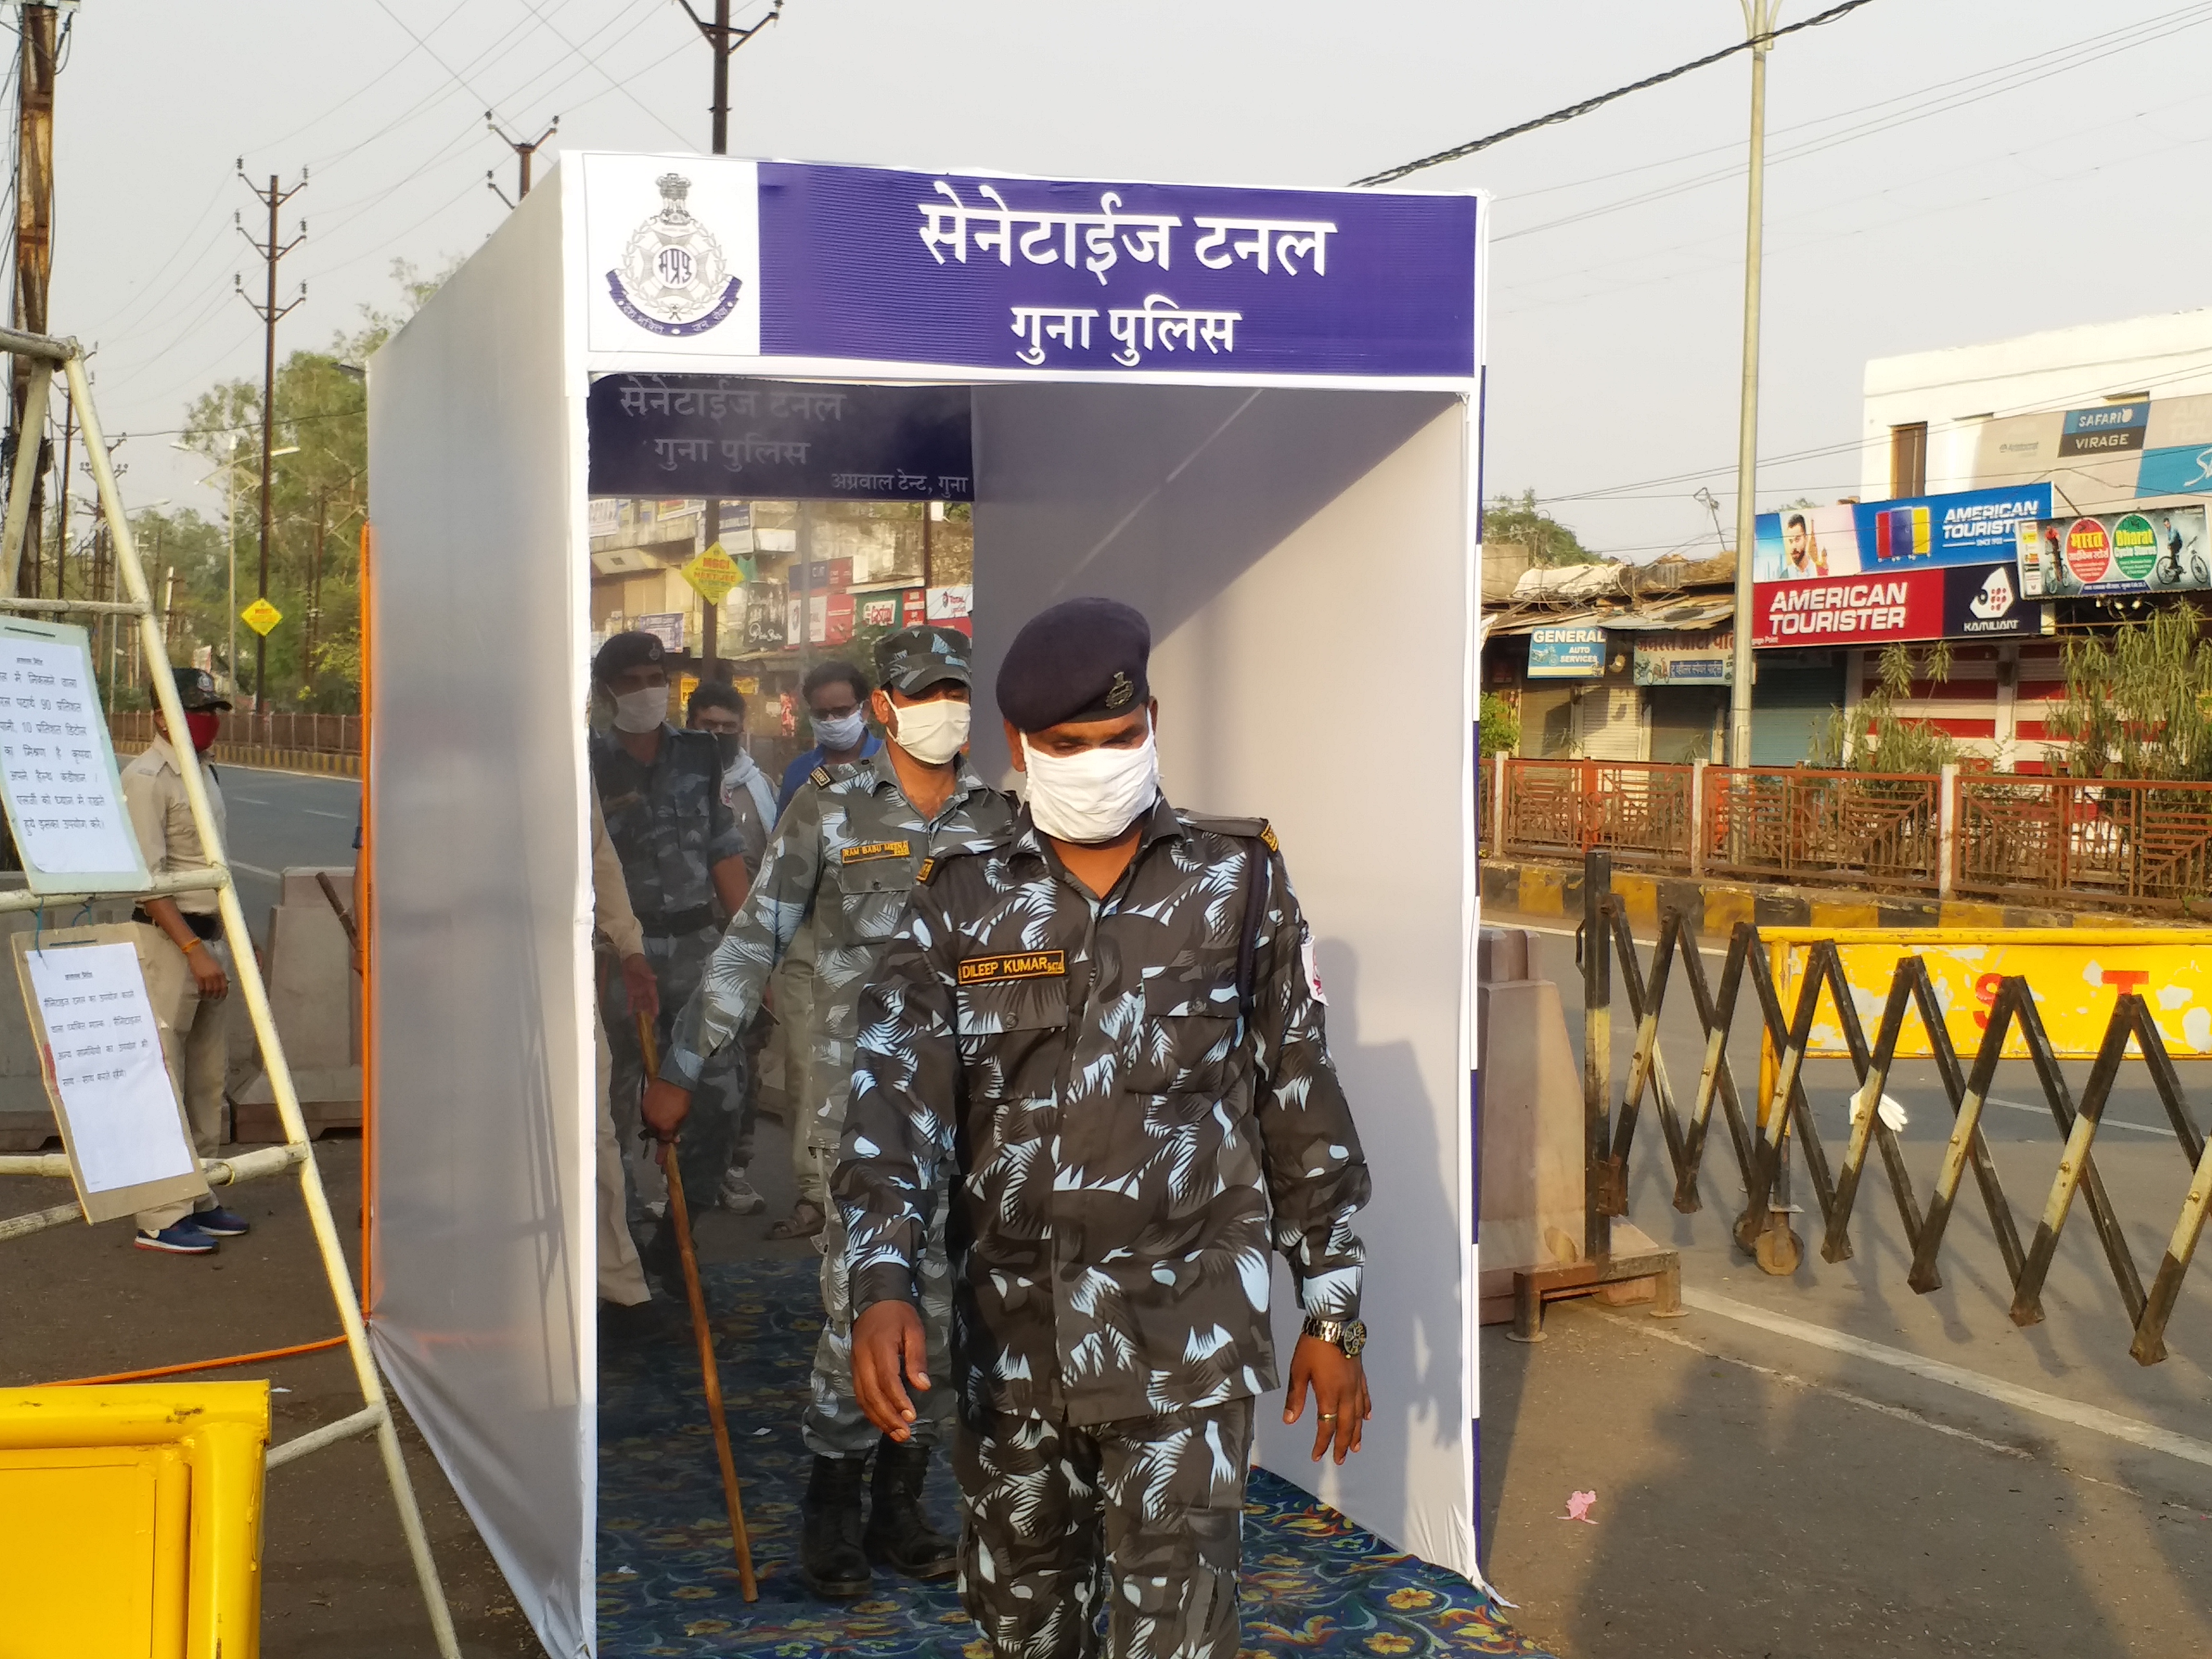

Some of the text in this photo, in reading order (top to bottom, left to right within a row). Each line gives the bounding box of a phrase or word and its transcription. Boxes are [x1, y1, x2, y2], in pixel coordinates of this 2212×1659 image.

[918, 180, 1338, 286] सेनेटाईज टनल
[1010, 294, 1243, 367] गुना पुलिस
[620, 374, 848, 423] सेनेटाईज टनल
[2078, 411, 2122, 428] SAFARI
[654, 432, 812, 472] गुना पुलिस
[2075, 433, 2130, 449] VIRAGE
[831, 473, 895, 491] अग्रवाल
[938, 475, 969, 498] गुना
[1944, 501, 2039, 523] AMERICAN
[1942, 518, 2015, 540] TOURIST
[2070, 531, 2104, 549] भारत
[2115, 529, 2154, 546] Bharat
[1769, 582, 1908, 613] AMERICAN
[1769, 607, 1906, 636] TOURISTER
[1533, 630, 1606, 643] GENERAL
[1560, 655, 1598, 663] SERVICES
[22, 721, 32, 733] 10
[962, 962, 999, 979] DILEEP
[1003, 957, 1048, 974] KUMAR
